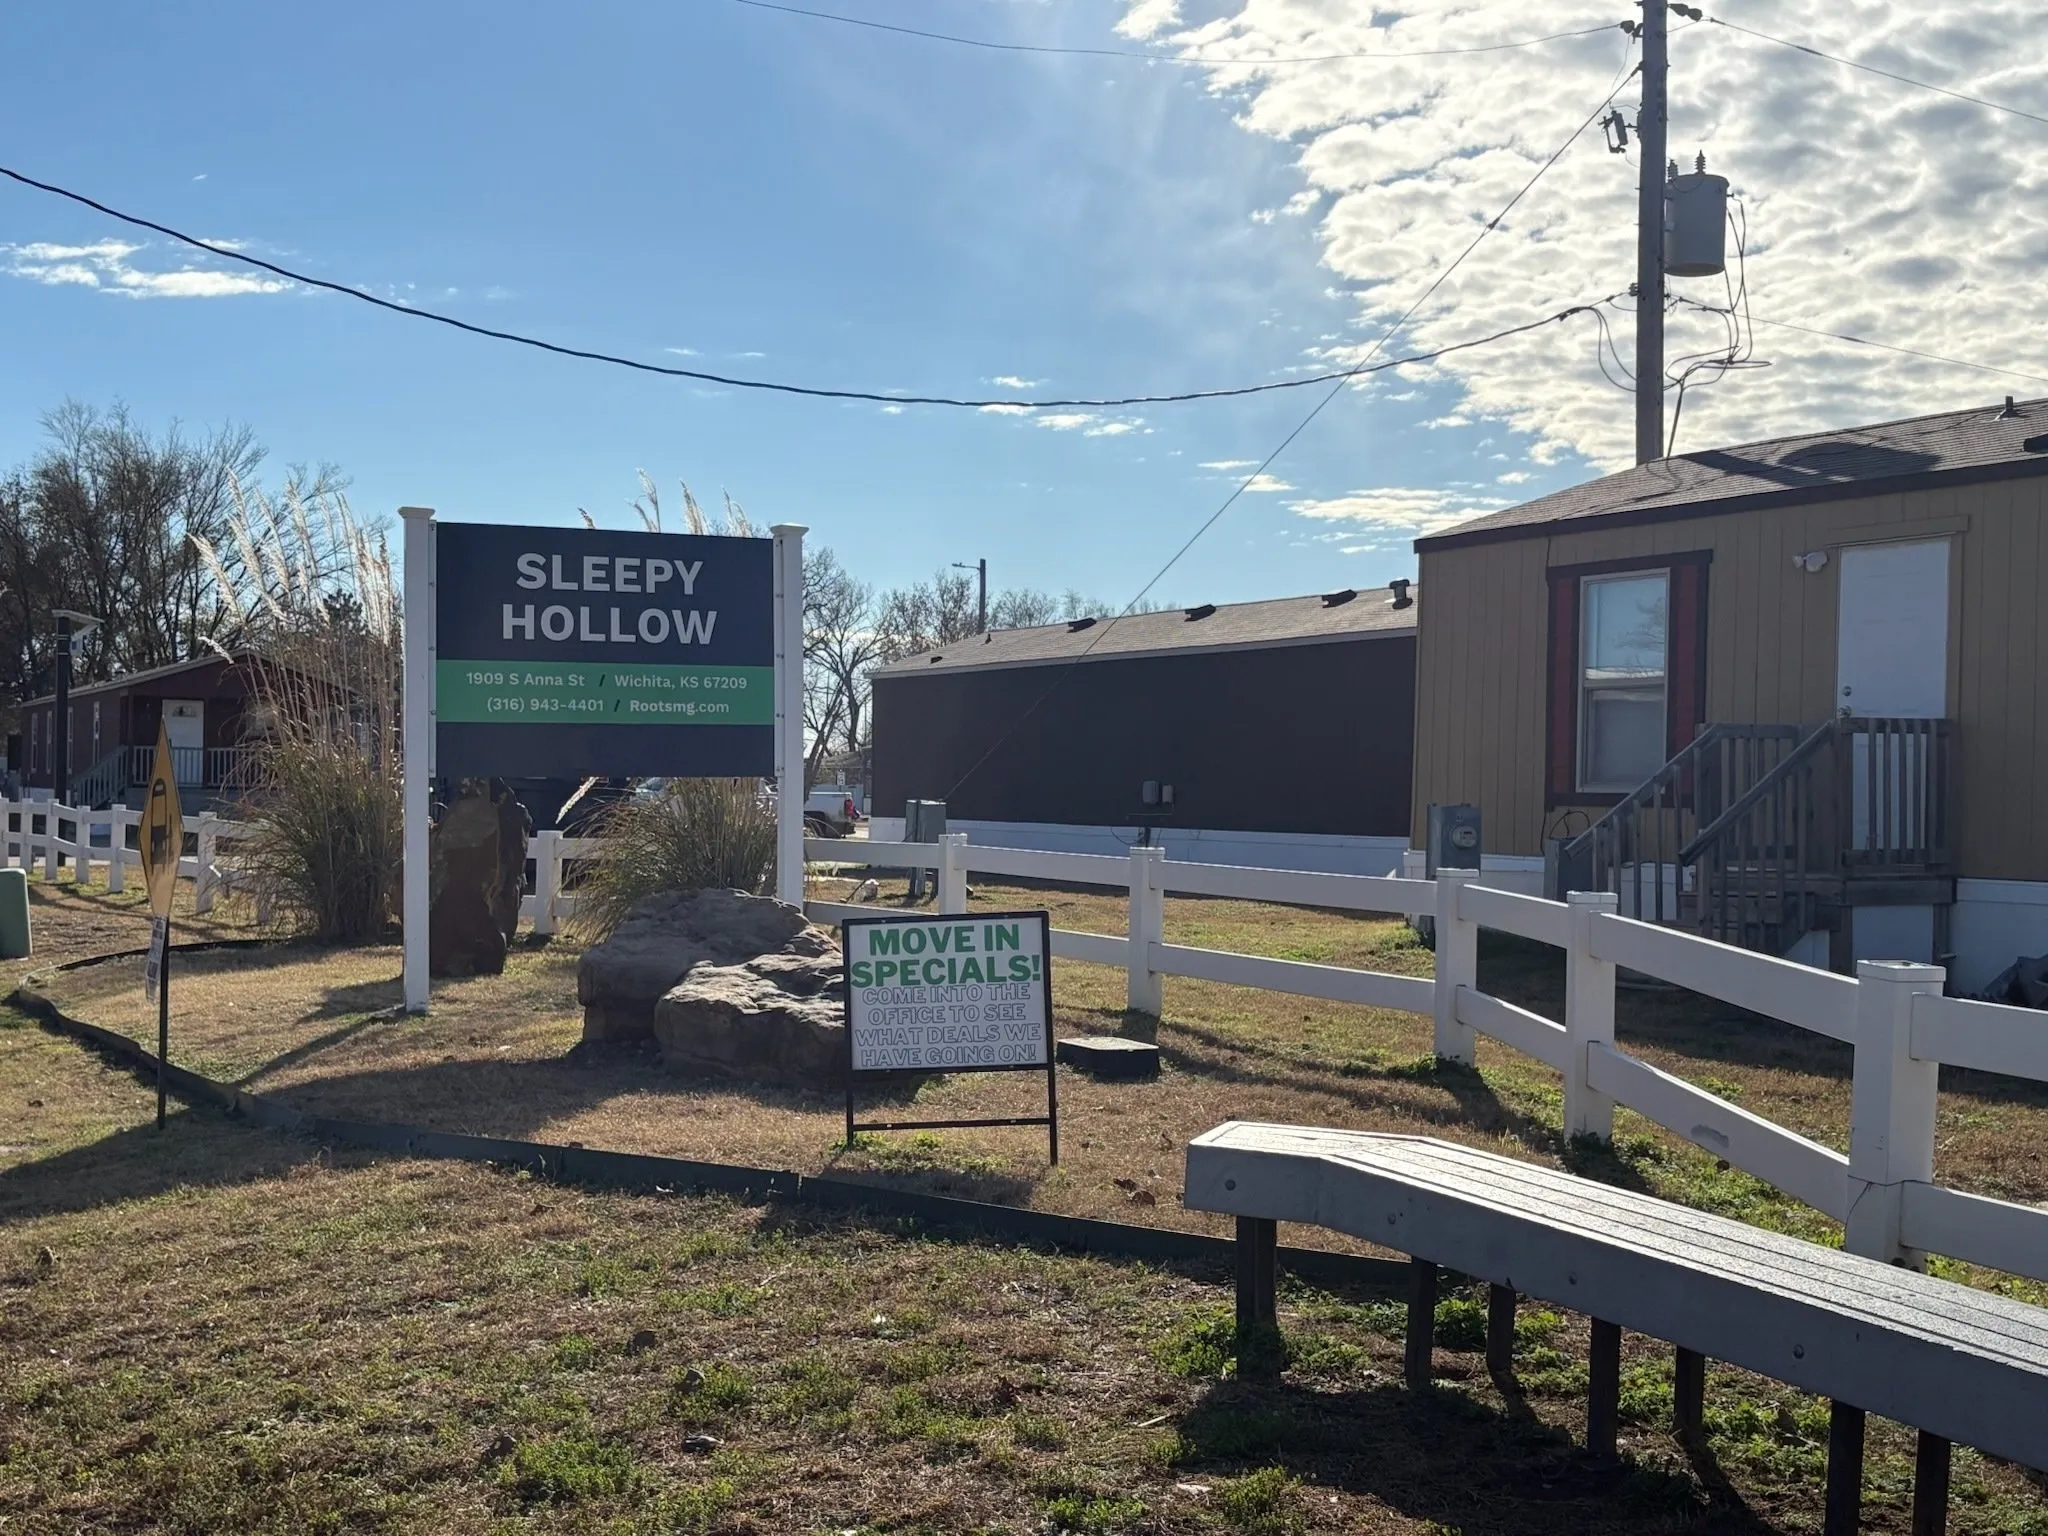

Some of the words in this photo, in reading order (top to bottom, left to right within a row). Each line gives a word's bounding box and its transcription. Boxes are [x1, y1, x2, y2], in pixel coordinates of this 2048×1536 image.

[516, 553, 704, 595] SLEEPY
[502, 604, 717, 645] HOLLOW
[466, 672, 504, 685] 1909
[509, 673, 519, 685] S
[524, 673, 563, 686] Anna
[568, 674, 585, 687] St
[614, 675, 675, 690] Wichita,
[680, 676, 699, 688] KS
[703, 676, 747, 689] 67209
[487, 697, 525, 712] (316)
[530, 698, 604, 711] 943-4401
[630, 700, 729, 716] Rootsmg.com
[869, 926, 976, 956] MOVE
[984, 924, 1019, 951] IN
[851, 954, 1040, 988] SPECIALS!
[862, 986, 927, 1005] COME
[930, 984, 982, 1003] INTO
[986, 983, 1031, 1000] THE
[868, 1006, 946, 1025] OFFICE
[949, 1005, 980, 1022] TO
[984, 1003, 1026, 1021] SEE
[854, 1028, 924, 1047] WHAT
[927, 1025, 1001, 1043] DEALS
[1004, 1023, 1041, 1041] WE
[861, 1048, 922, 1067] HAVE
[925, 1045, 995, 1064] GOING
[998, 1044, 1037, 1062] ON!
